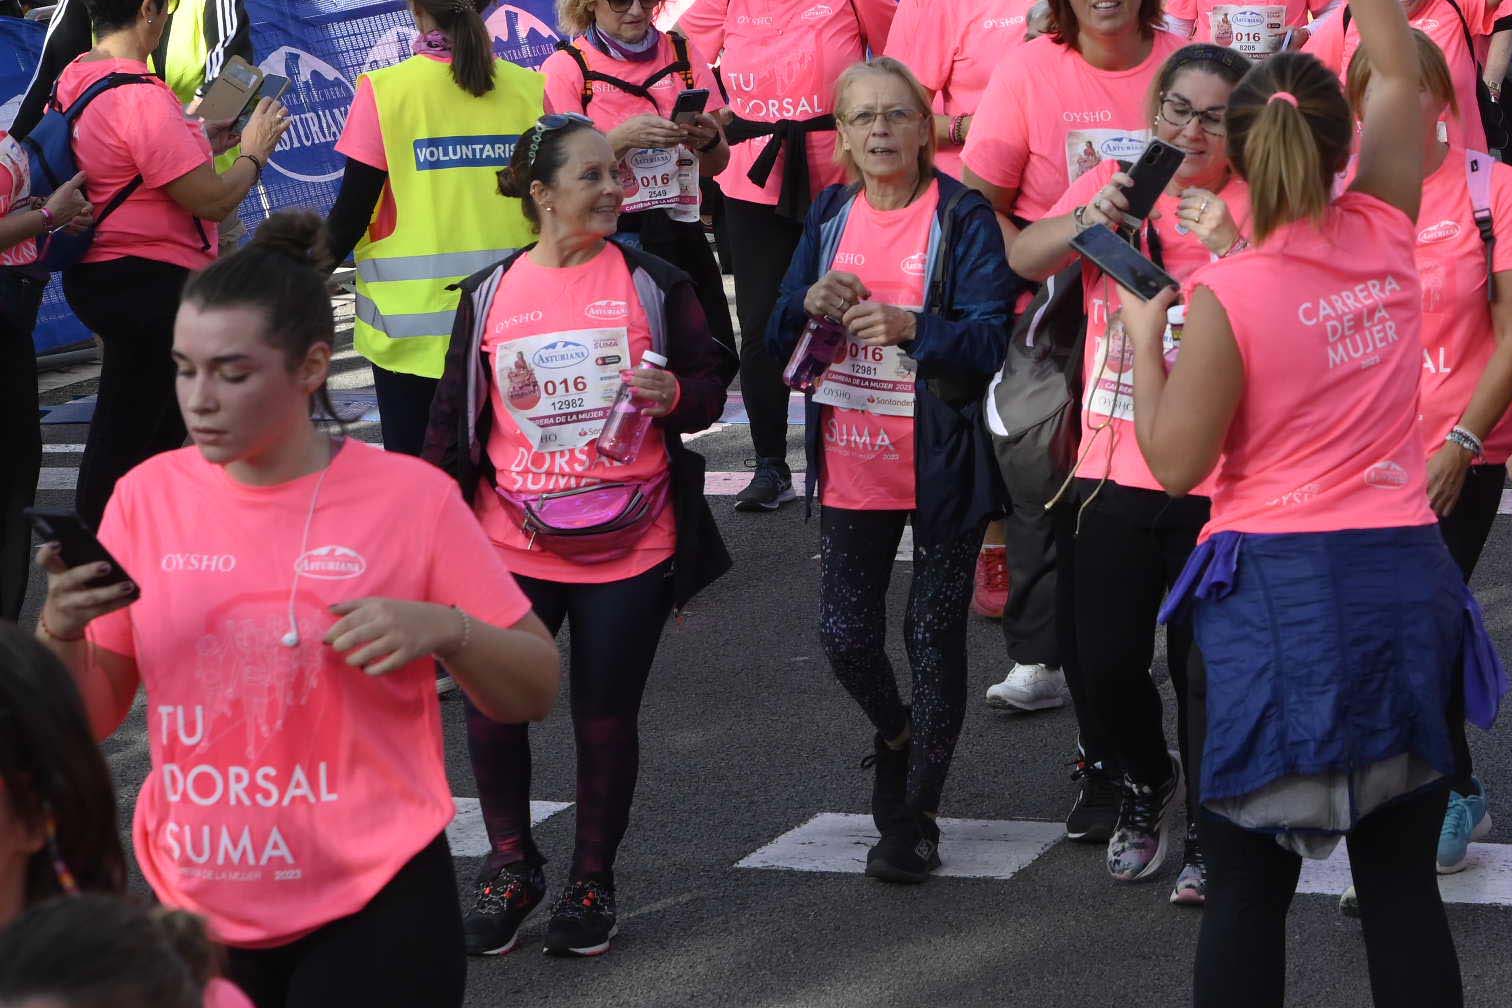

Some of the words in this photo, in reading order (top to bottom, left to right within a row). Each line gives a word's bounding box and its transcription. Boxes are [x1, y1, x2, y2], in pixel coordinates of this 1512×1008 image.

[1235, 32, 1261, 42] 016
[728, 73, 755, 91] TU
[1063, 109, 1113, 123] OYSHO
[640, 173, 670, 188] 016
[1298, 275, 1400, 326] CARRERA
[1326, 314, 1356, 343] DE
[1362, 304, 1389, 328] LA
[849, 345, 884, 362] 016
[1327, 321, 1399, 369] MUJER
[536, 348, 586, 365] ASTURIANA
[851, 364, 877, 376] 12981
[543, 376, 588, 396] 016
[551, 397, 585, 411] 12982
[876, 396, 915, 407] Santander
[555, 415, 566, 424] DE
[566, 413, 578, 423] LA
[825, 419, 895, 451] SUMA
[161, 554, 237, 572] OYSHO
[299, 558, 361, 573] ASTURIANA
[157, 704, 204, 746] TU
[162, 761, 339, 807] DORSAL
[164, 822, 295, 866] SUMA
